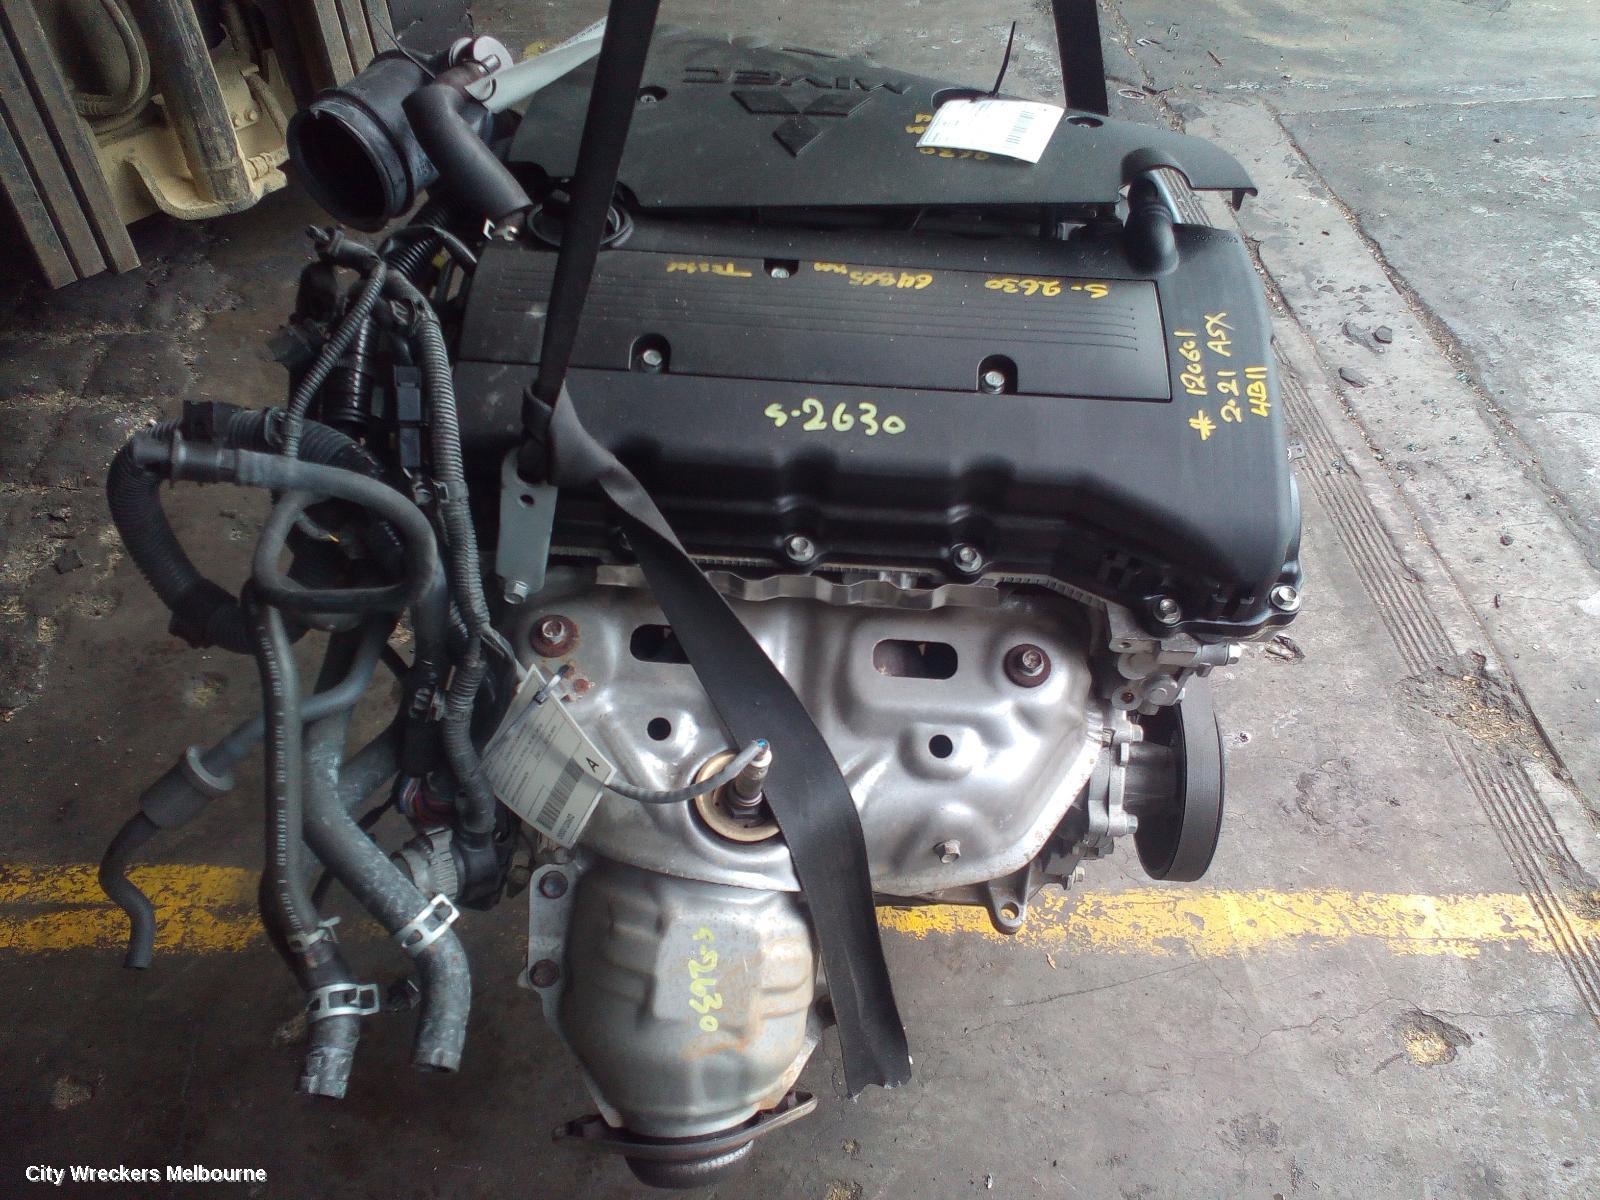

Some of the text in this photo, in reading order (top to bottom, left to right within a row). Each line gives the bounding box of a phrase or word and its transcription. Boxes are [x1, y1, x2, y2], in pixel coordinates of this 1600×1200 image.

[681, 66, 912, 96] MIVEC
[1204, 312, 1236, 358] ASX
[1244, 366, 1272, 418] 4B11
[585, 756, 600, 774] A
